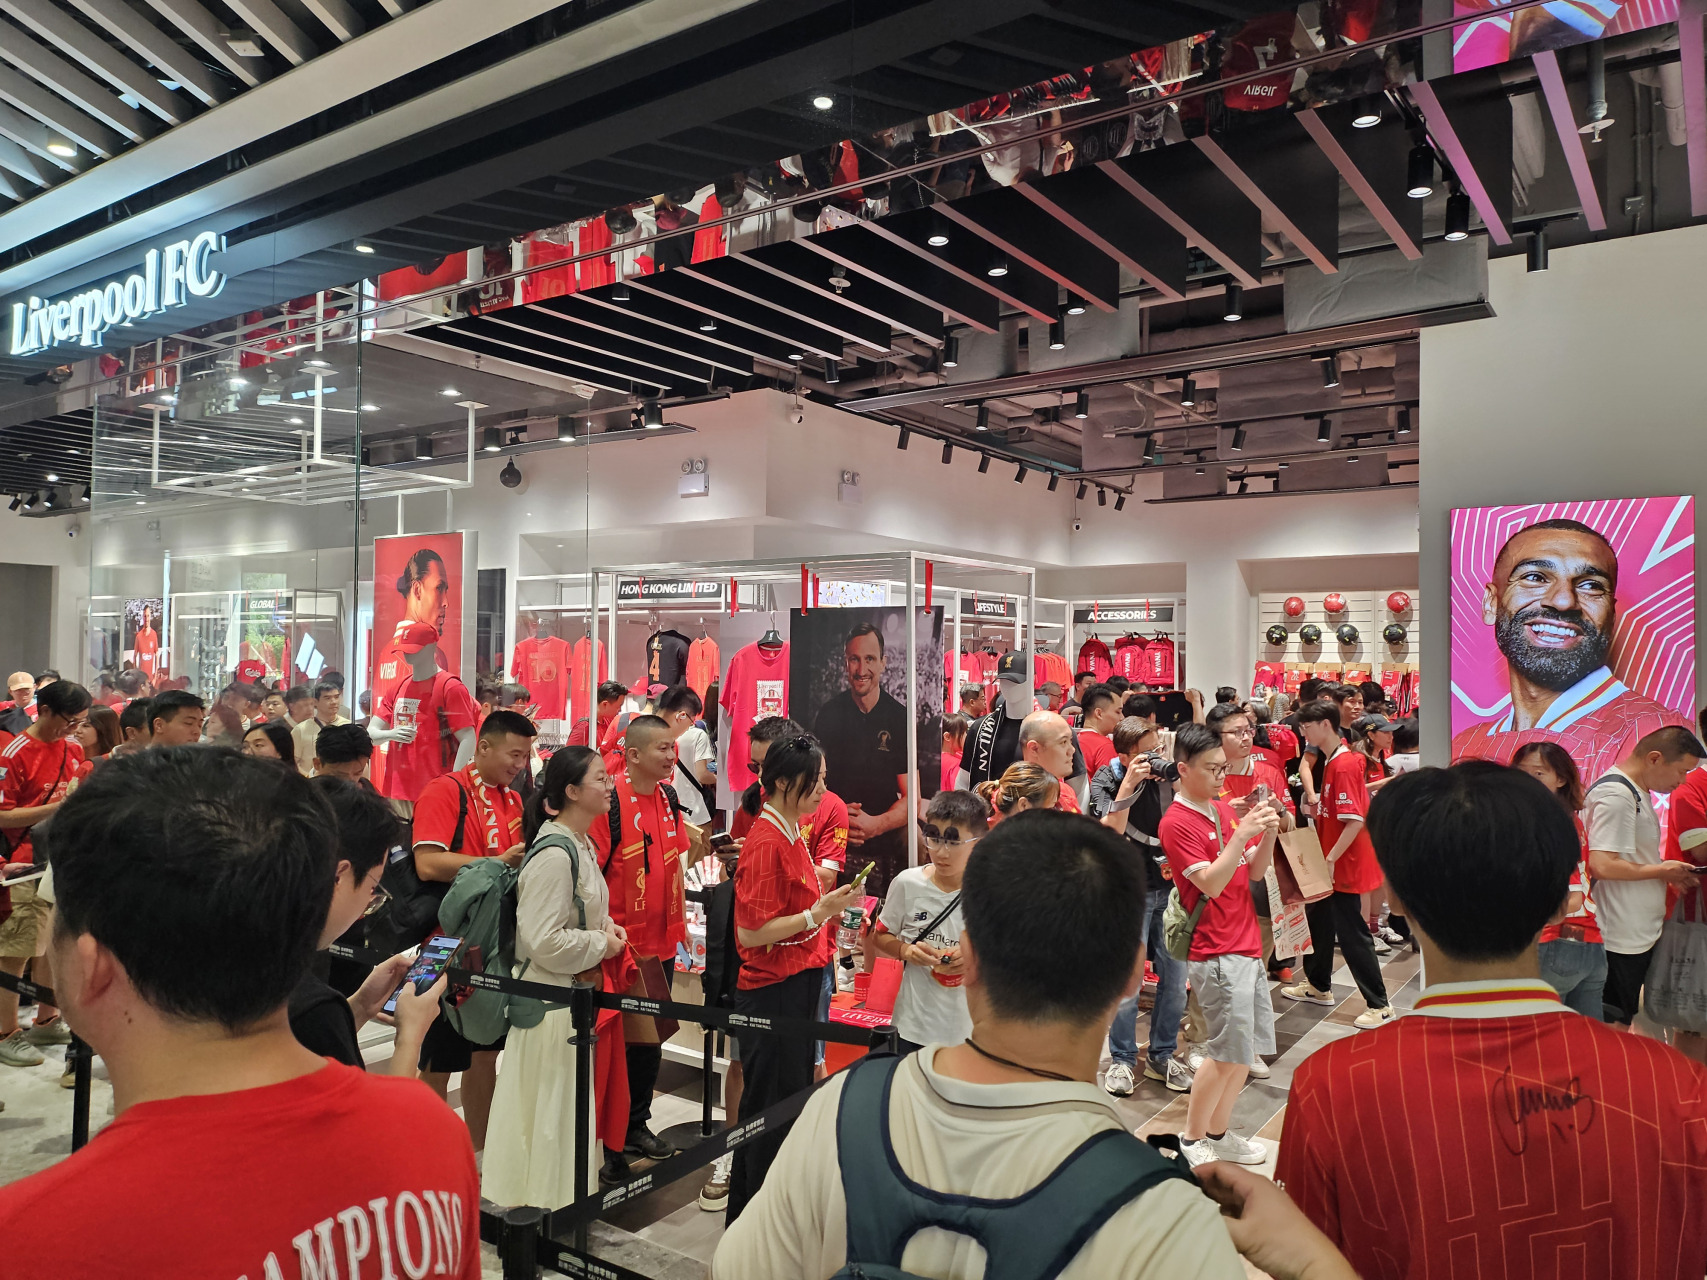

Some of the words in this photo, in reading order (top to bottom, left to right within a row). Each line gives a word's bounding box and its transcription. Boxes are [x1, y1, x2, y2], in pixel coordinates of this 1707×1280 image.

[10, 248, 162, 356] Liverpool
[163, 231, 222, 306] FC
[621, 585, 648, 595] HONG
[649, 584, 677, 594] KONG
[678, 583, 718, 593] LIMITED
[250, 600, 275, 609] GLOBAL
[1088, 610, 1157, 620] ACCESSORIES
